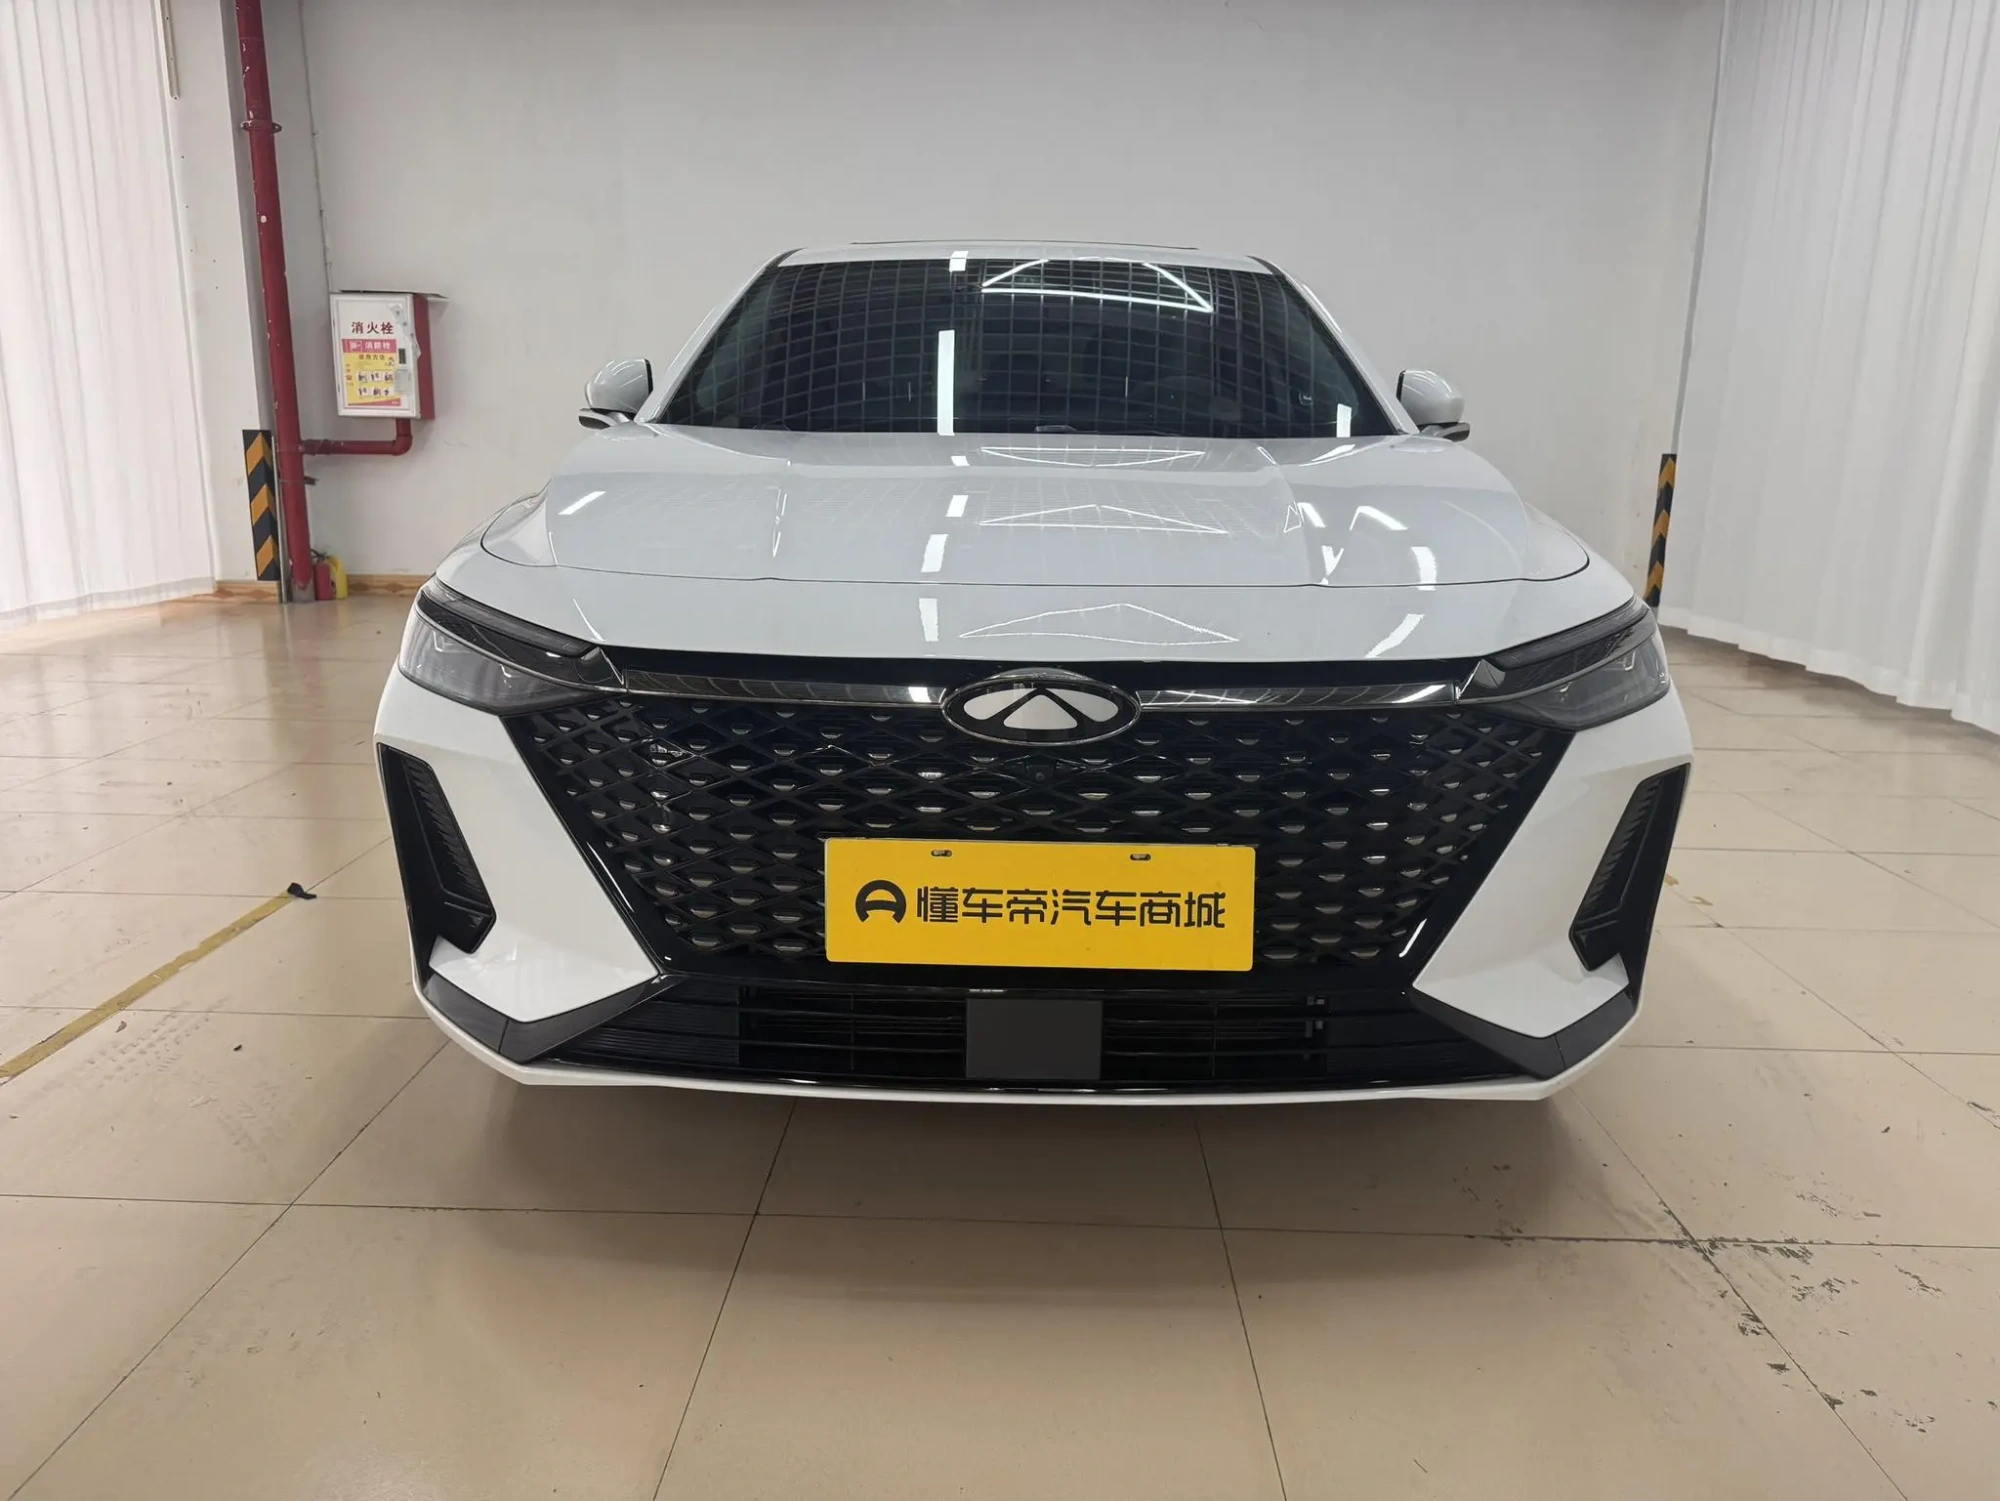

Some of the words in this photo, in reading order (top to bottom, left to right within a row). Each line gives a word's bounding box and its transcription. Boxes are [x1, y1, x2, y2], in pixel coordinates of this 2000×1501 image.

[351, 321, 394, 334] 消火栓
[916, 886, 1226, 929] 懂车帝汽车商城
